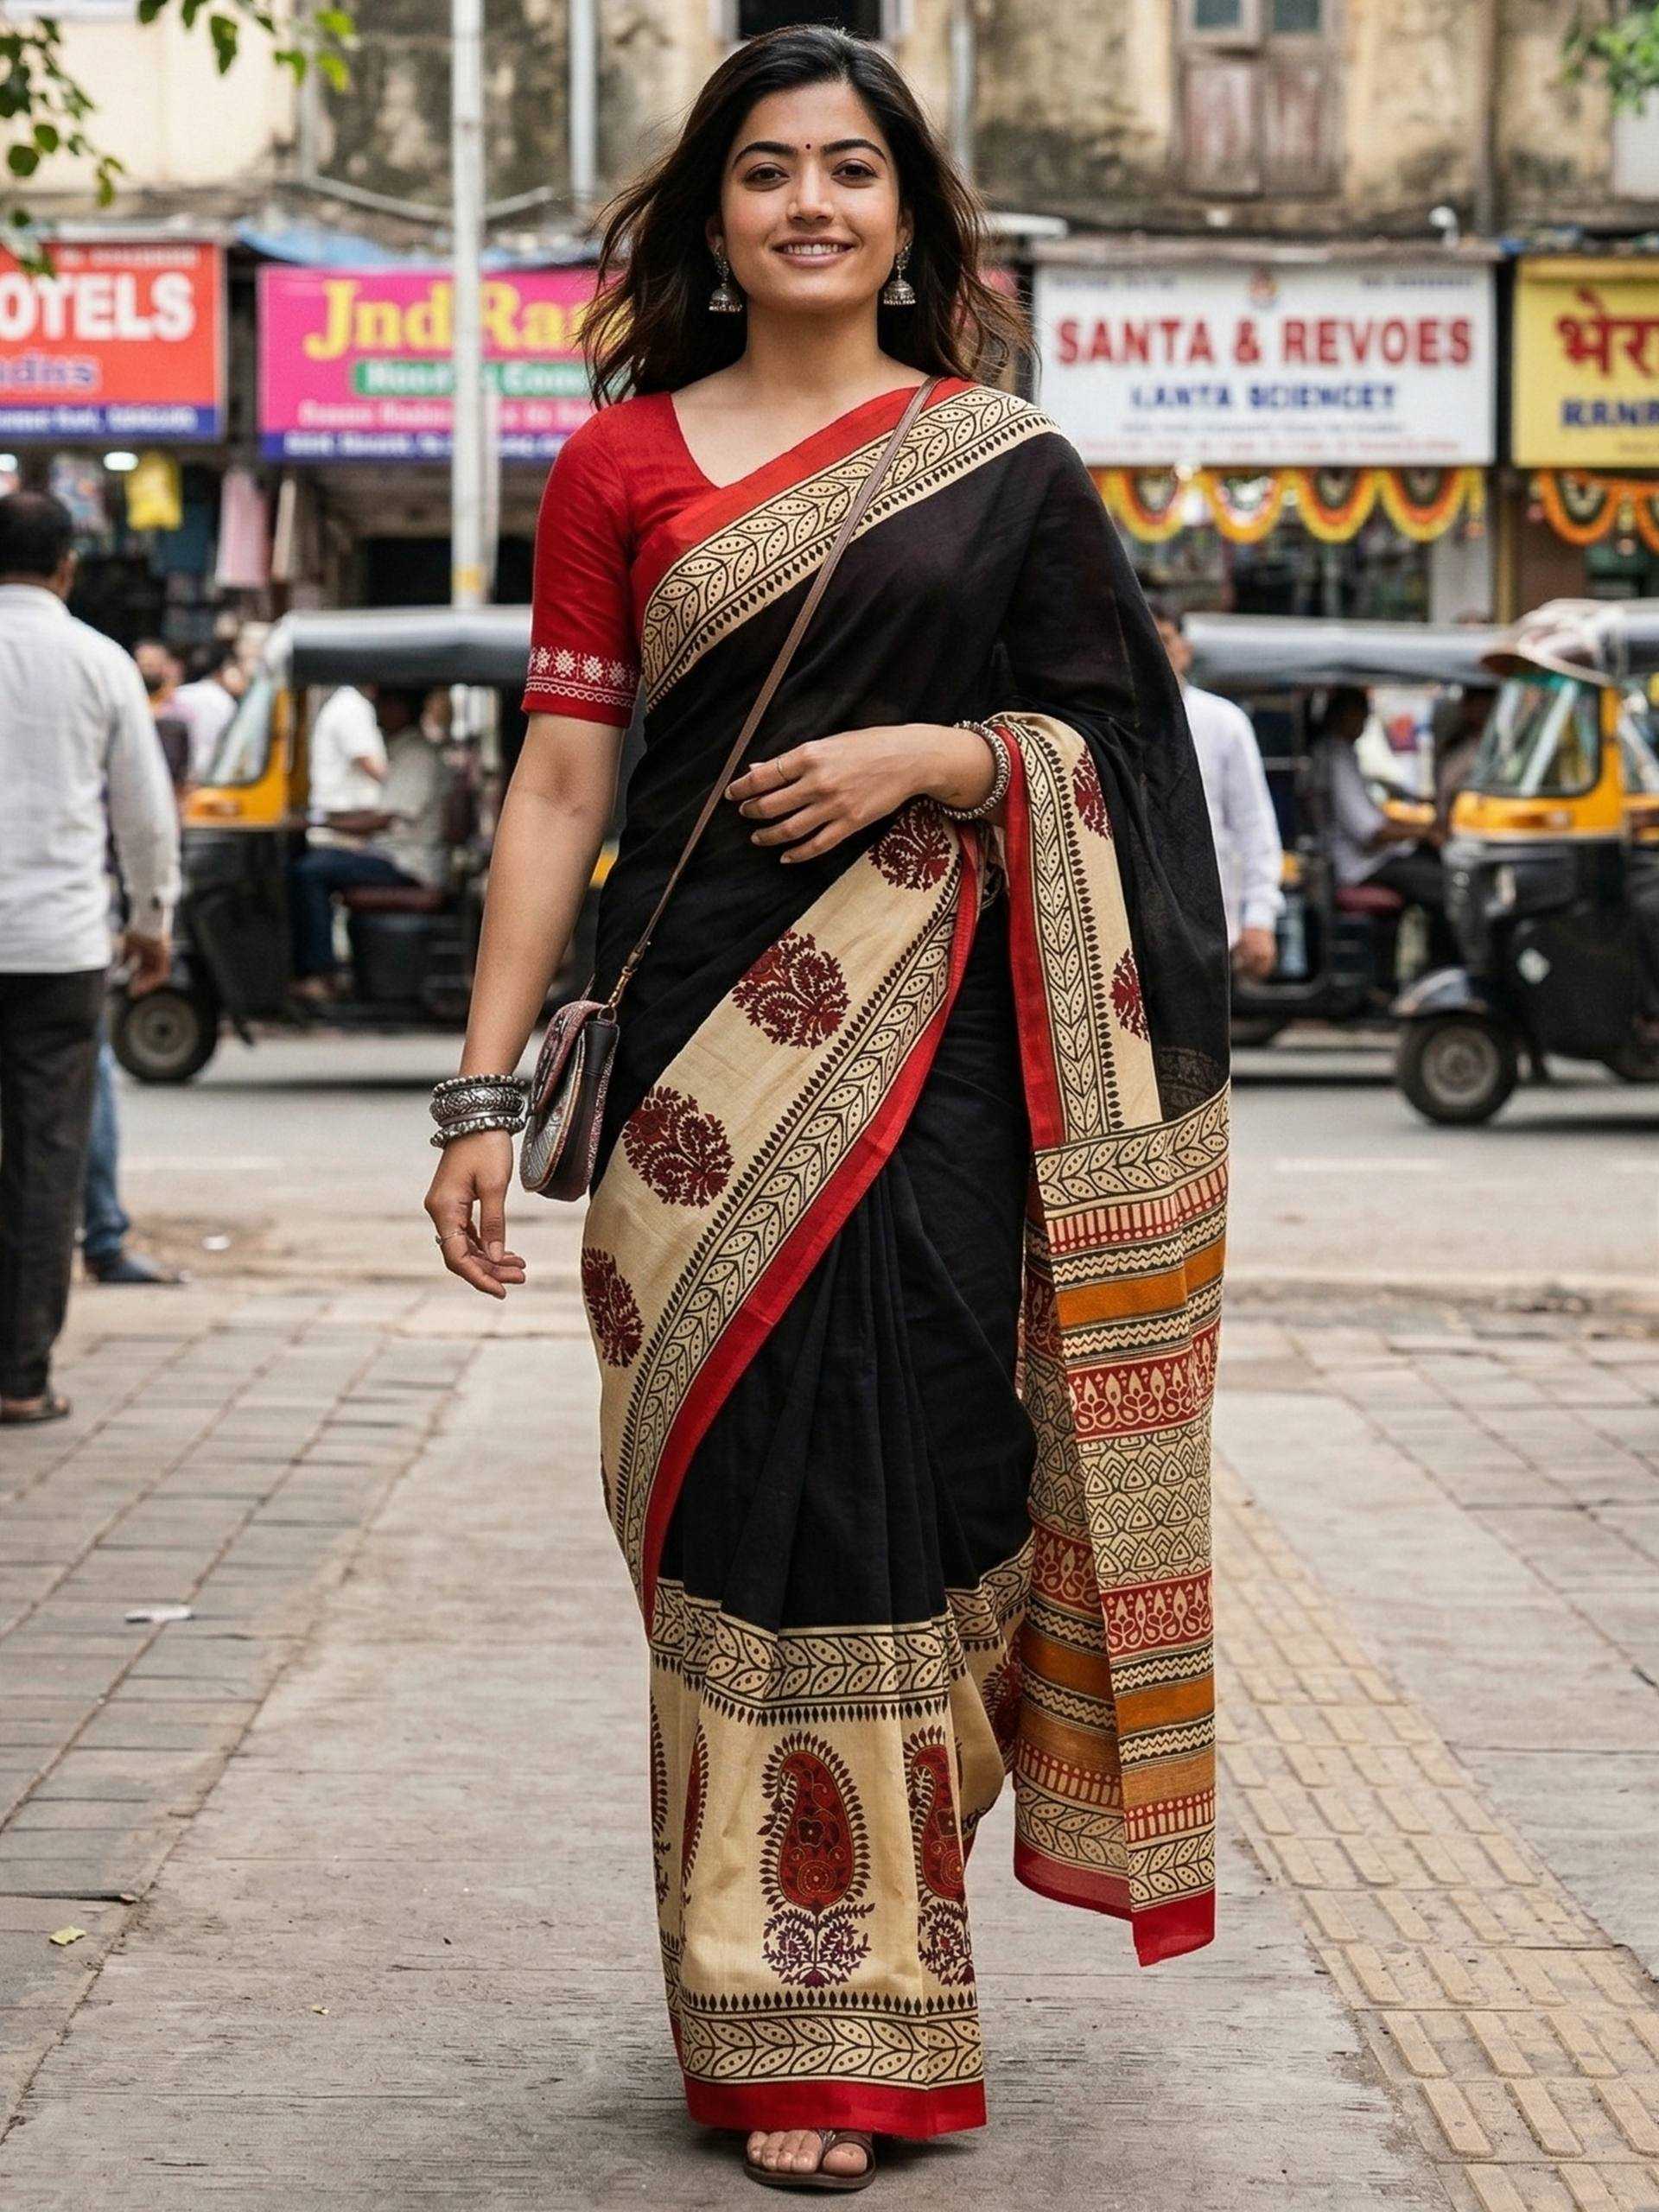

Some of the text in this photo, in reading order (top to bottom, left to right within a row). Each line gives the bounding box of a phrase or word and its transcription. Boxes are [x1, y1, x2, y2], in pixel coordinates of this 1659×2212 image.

[1056, 316, 1472, 366] SANTA & REVOES
